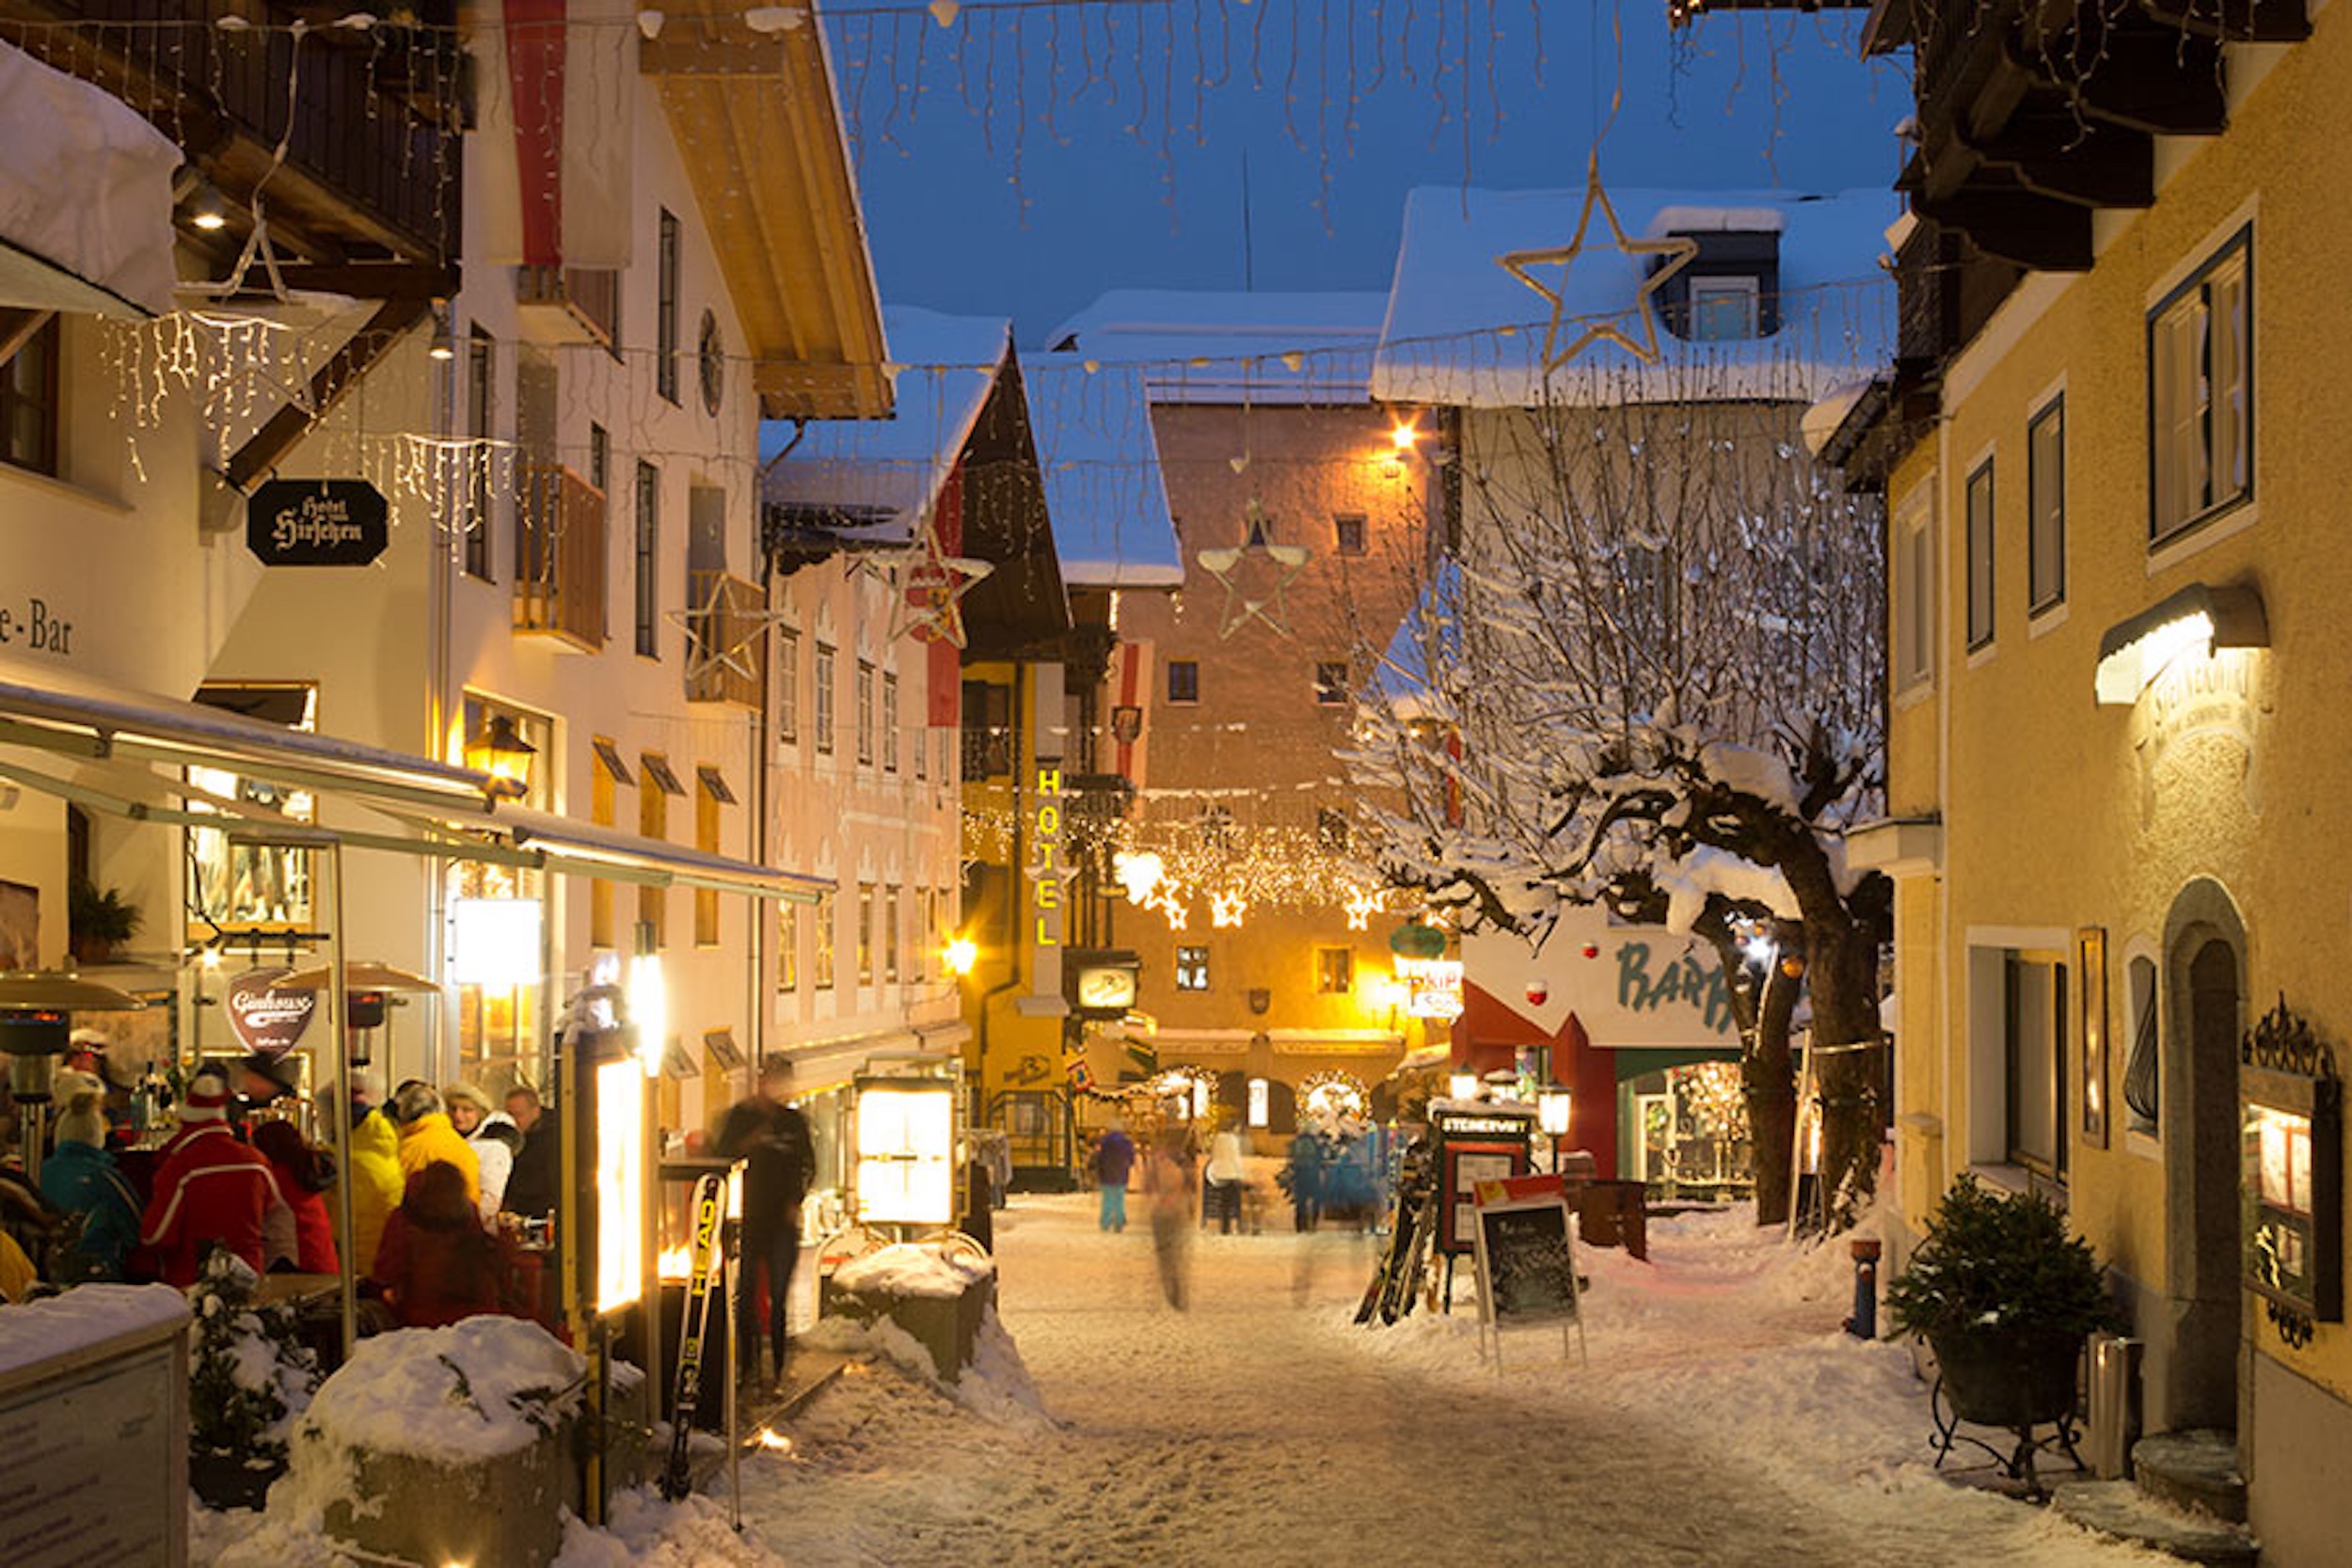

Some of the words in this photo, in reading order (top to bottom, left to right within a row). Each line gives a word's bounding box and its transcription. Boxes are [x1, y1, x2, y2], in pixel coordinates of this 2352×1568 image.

[302, 495, 347, 518] Hotel
[1037, 768, 1060, 946] HOTEL
[691, 1197, 716, 1297] HEAD
